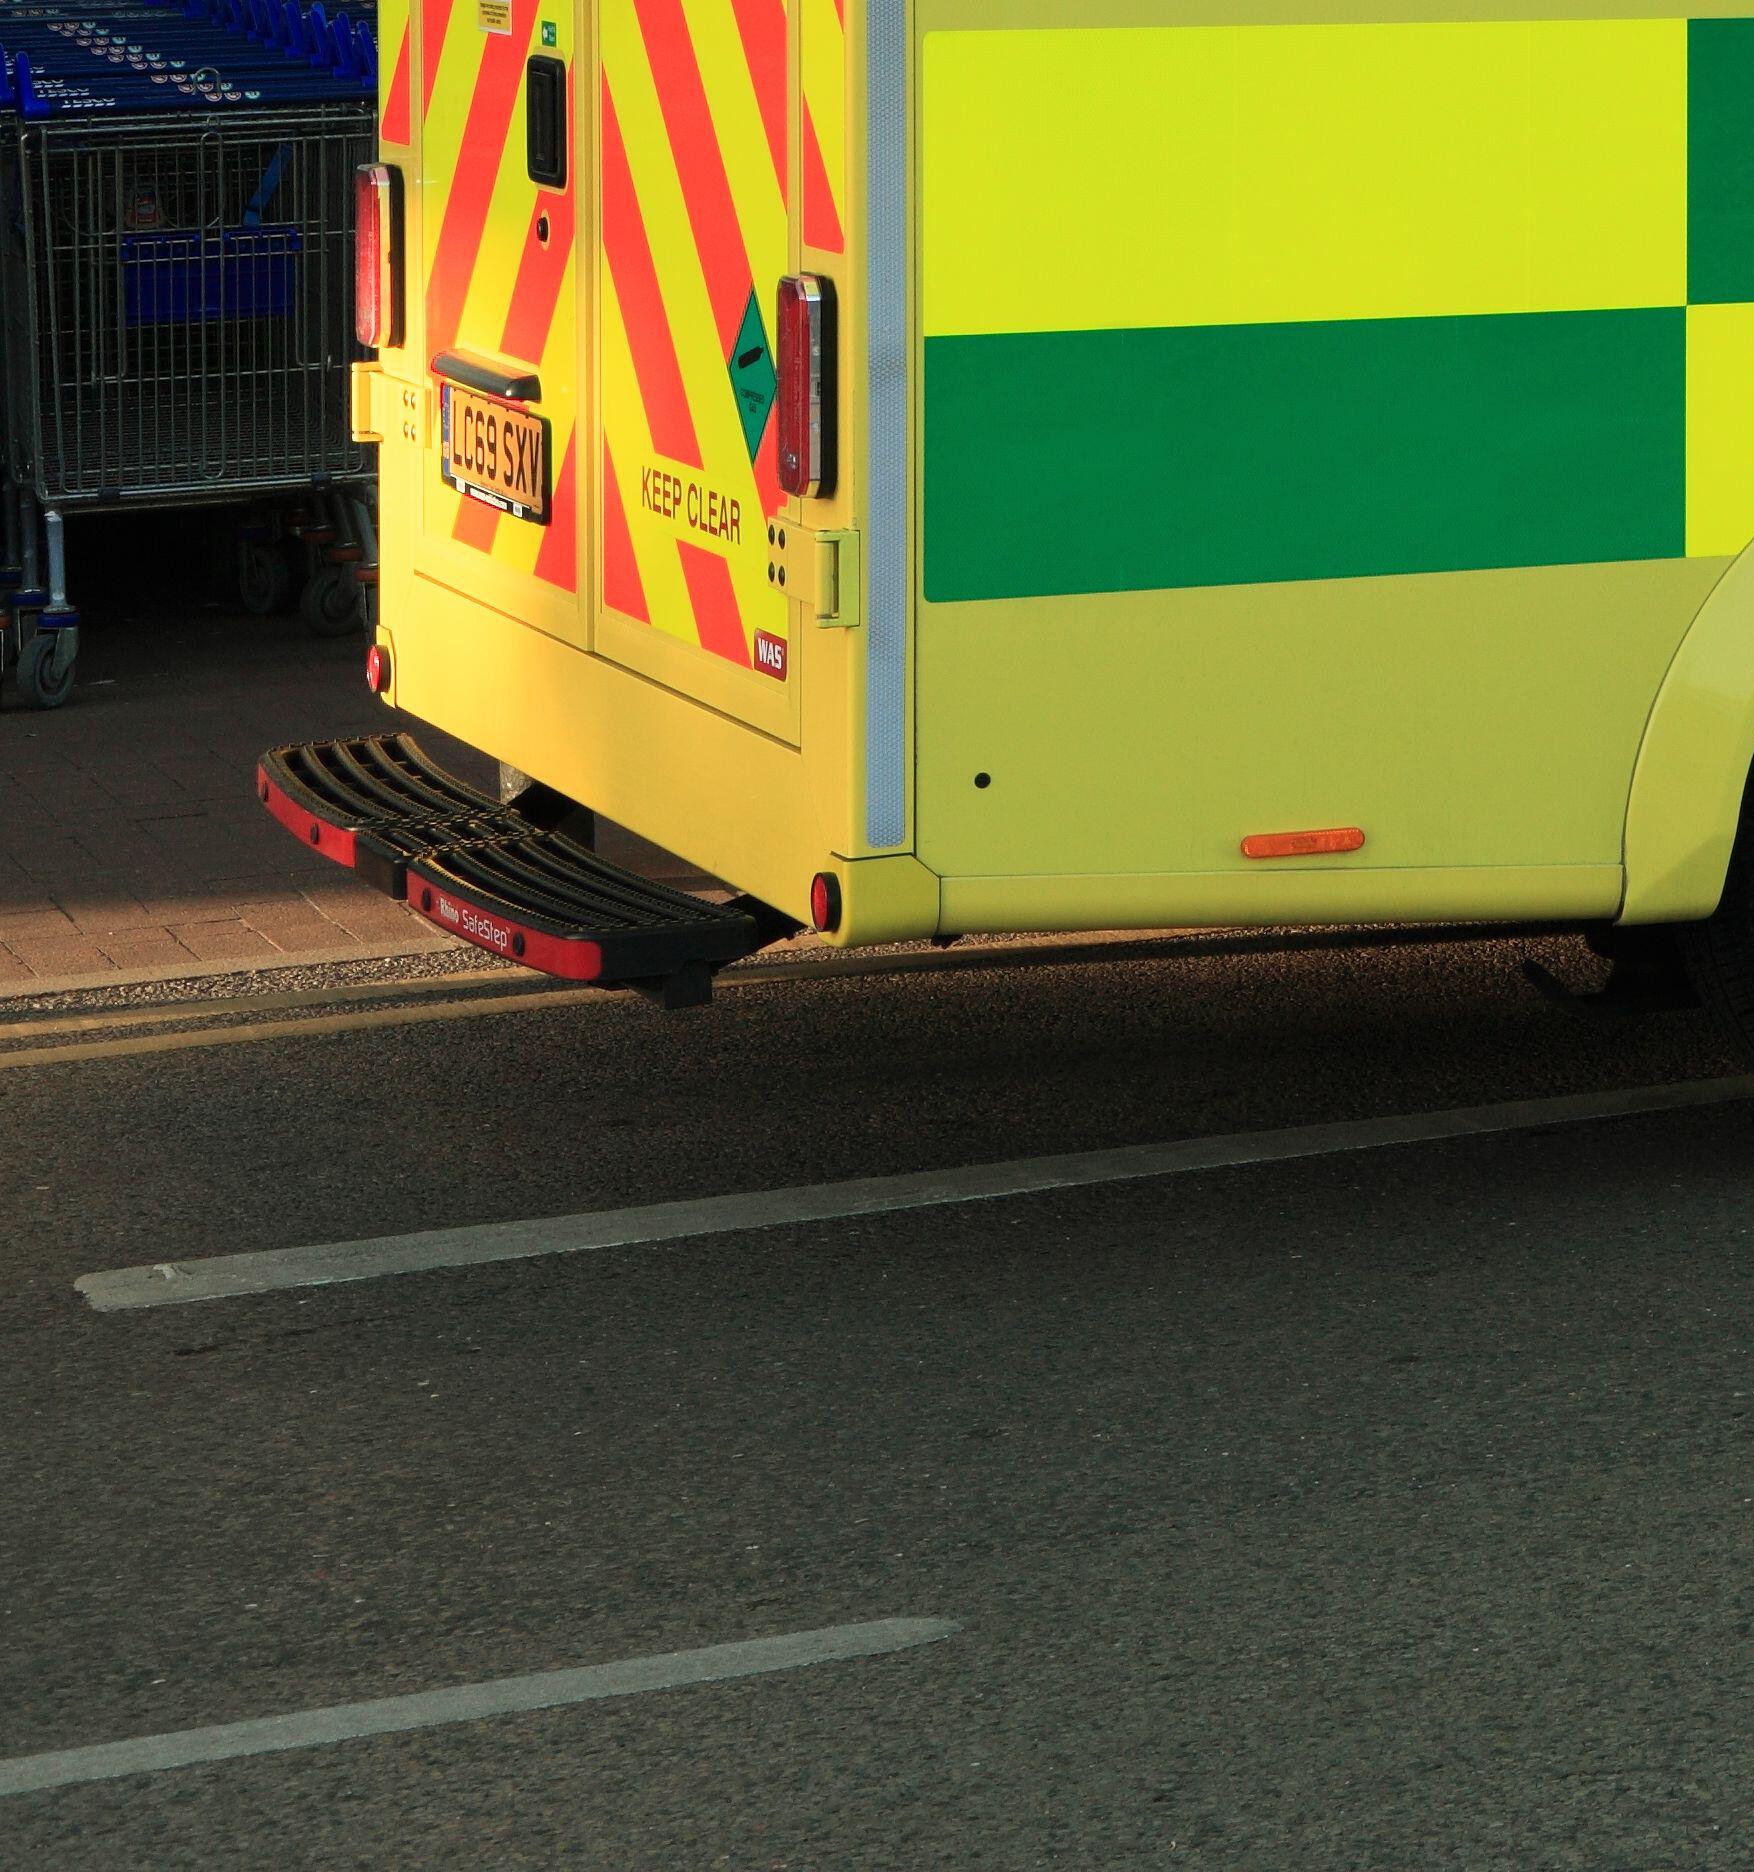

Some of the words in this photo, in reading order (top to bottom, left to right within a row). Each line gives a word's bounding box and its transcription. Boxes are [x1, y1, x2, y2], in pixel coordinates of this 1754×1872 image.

[453, 400, 496, 481] LC69
[503, 420, 539, 497] SXV
[641, 465, 683, 522] KEEP
[687, 481, 742, 546] CLEAR
[757, 636, 784, 670] WAS
[439, 896, 459, 925] Rhino
